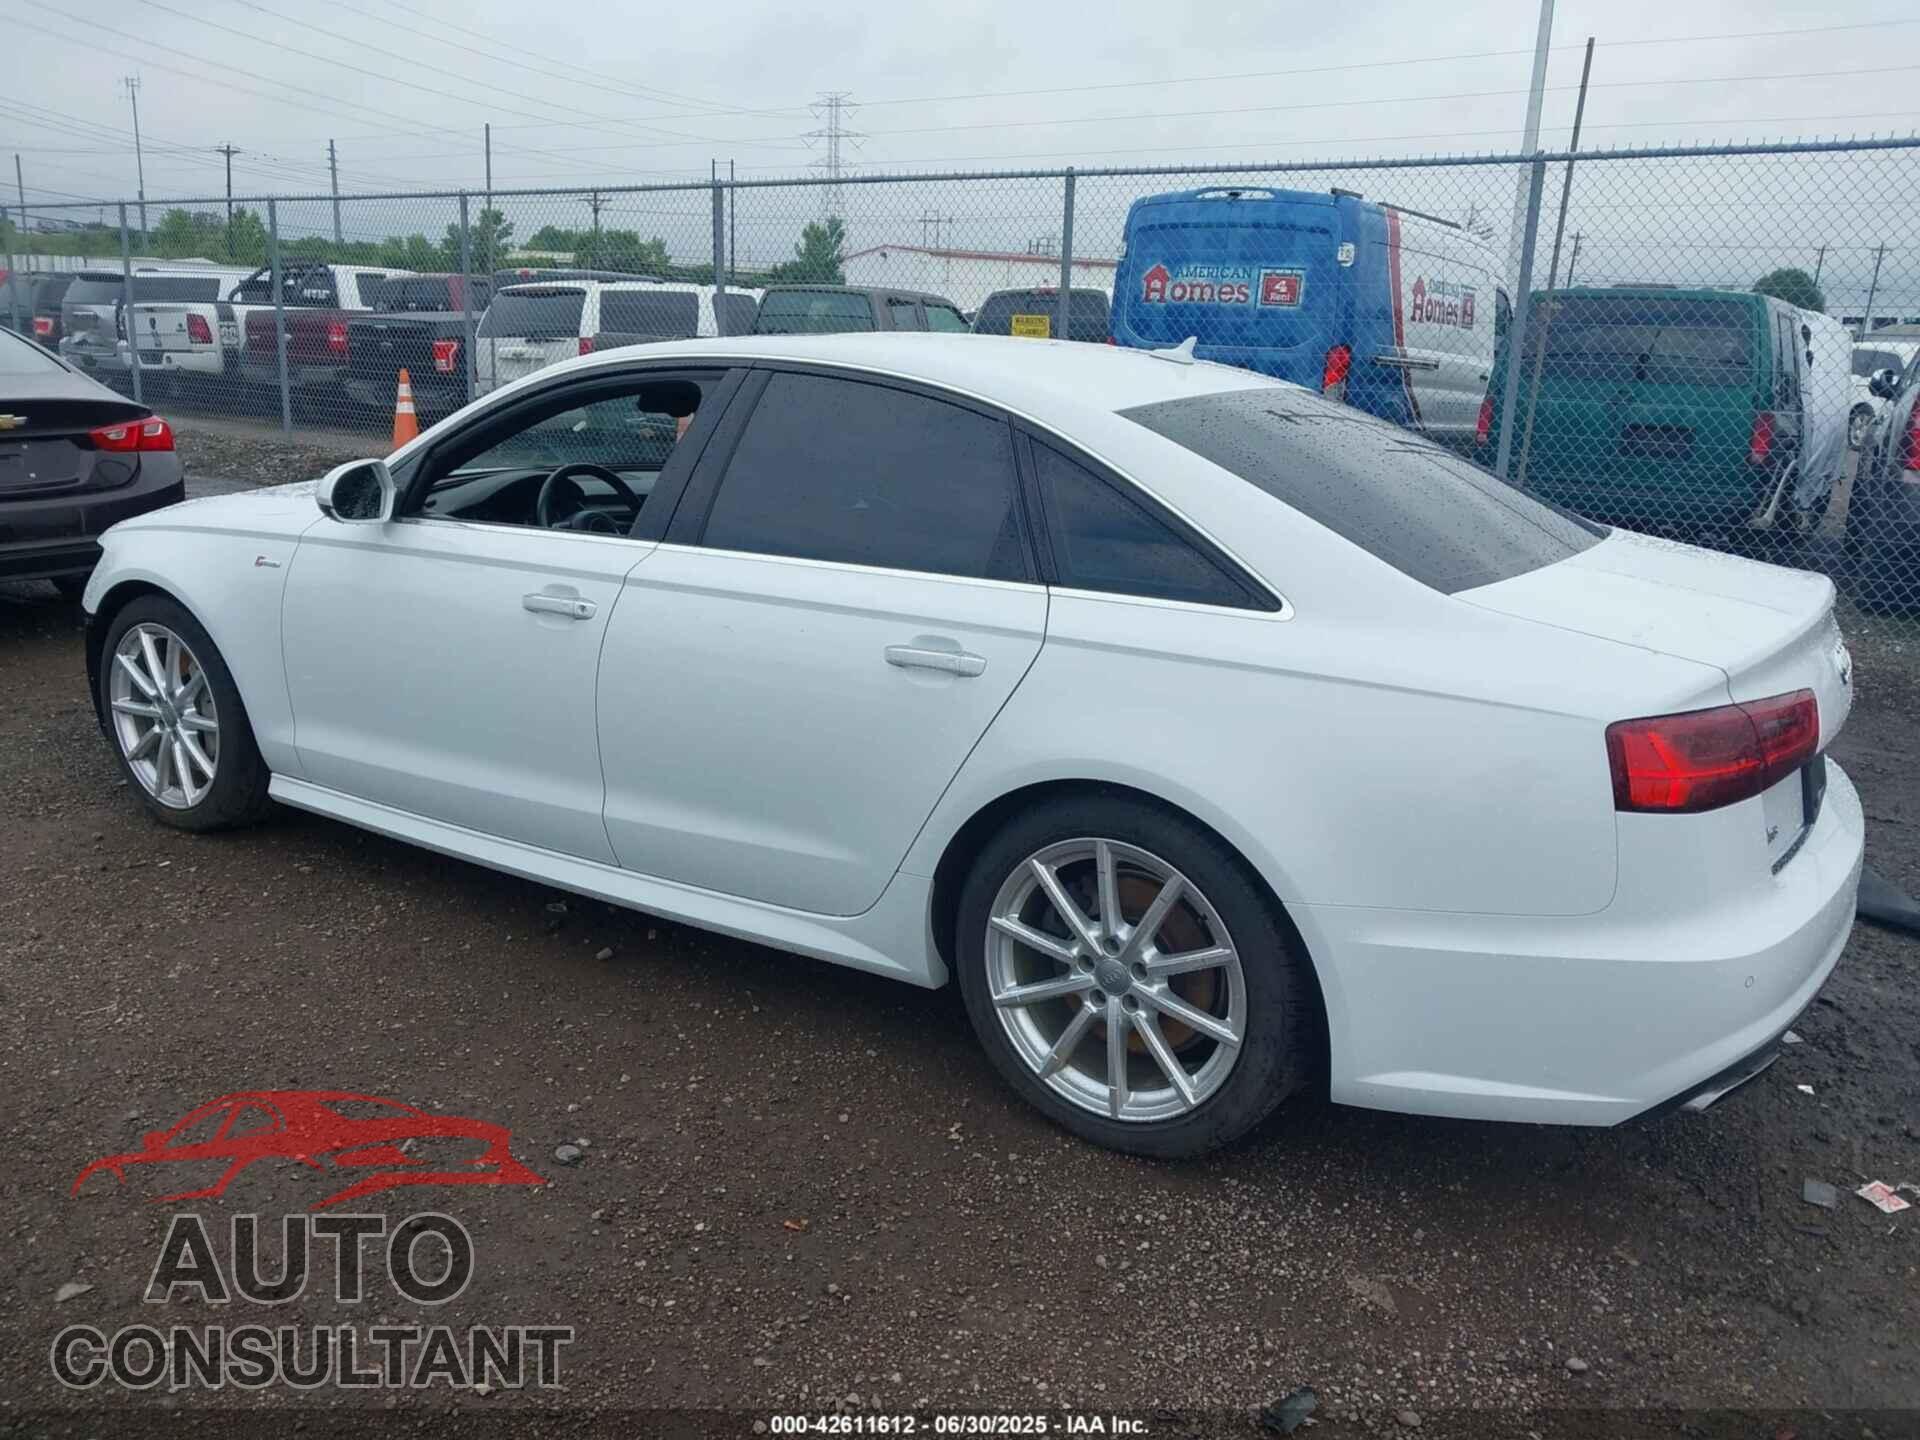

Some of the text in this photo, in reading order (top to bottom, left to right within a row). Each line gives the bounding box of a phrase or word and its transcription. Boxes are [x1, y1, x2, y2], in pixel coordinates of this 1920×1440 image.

[1143, 264, 1250, 304] Homes
[1176, 266, 1251, 279] AMERICAN
[1274, 280, 1288, 293] 4
[1410, 275, 1458, 325] Homes
